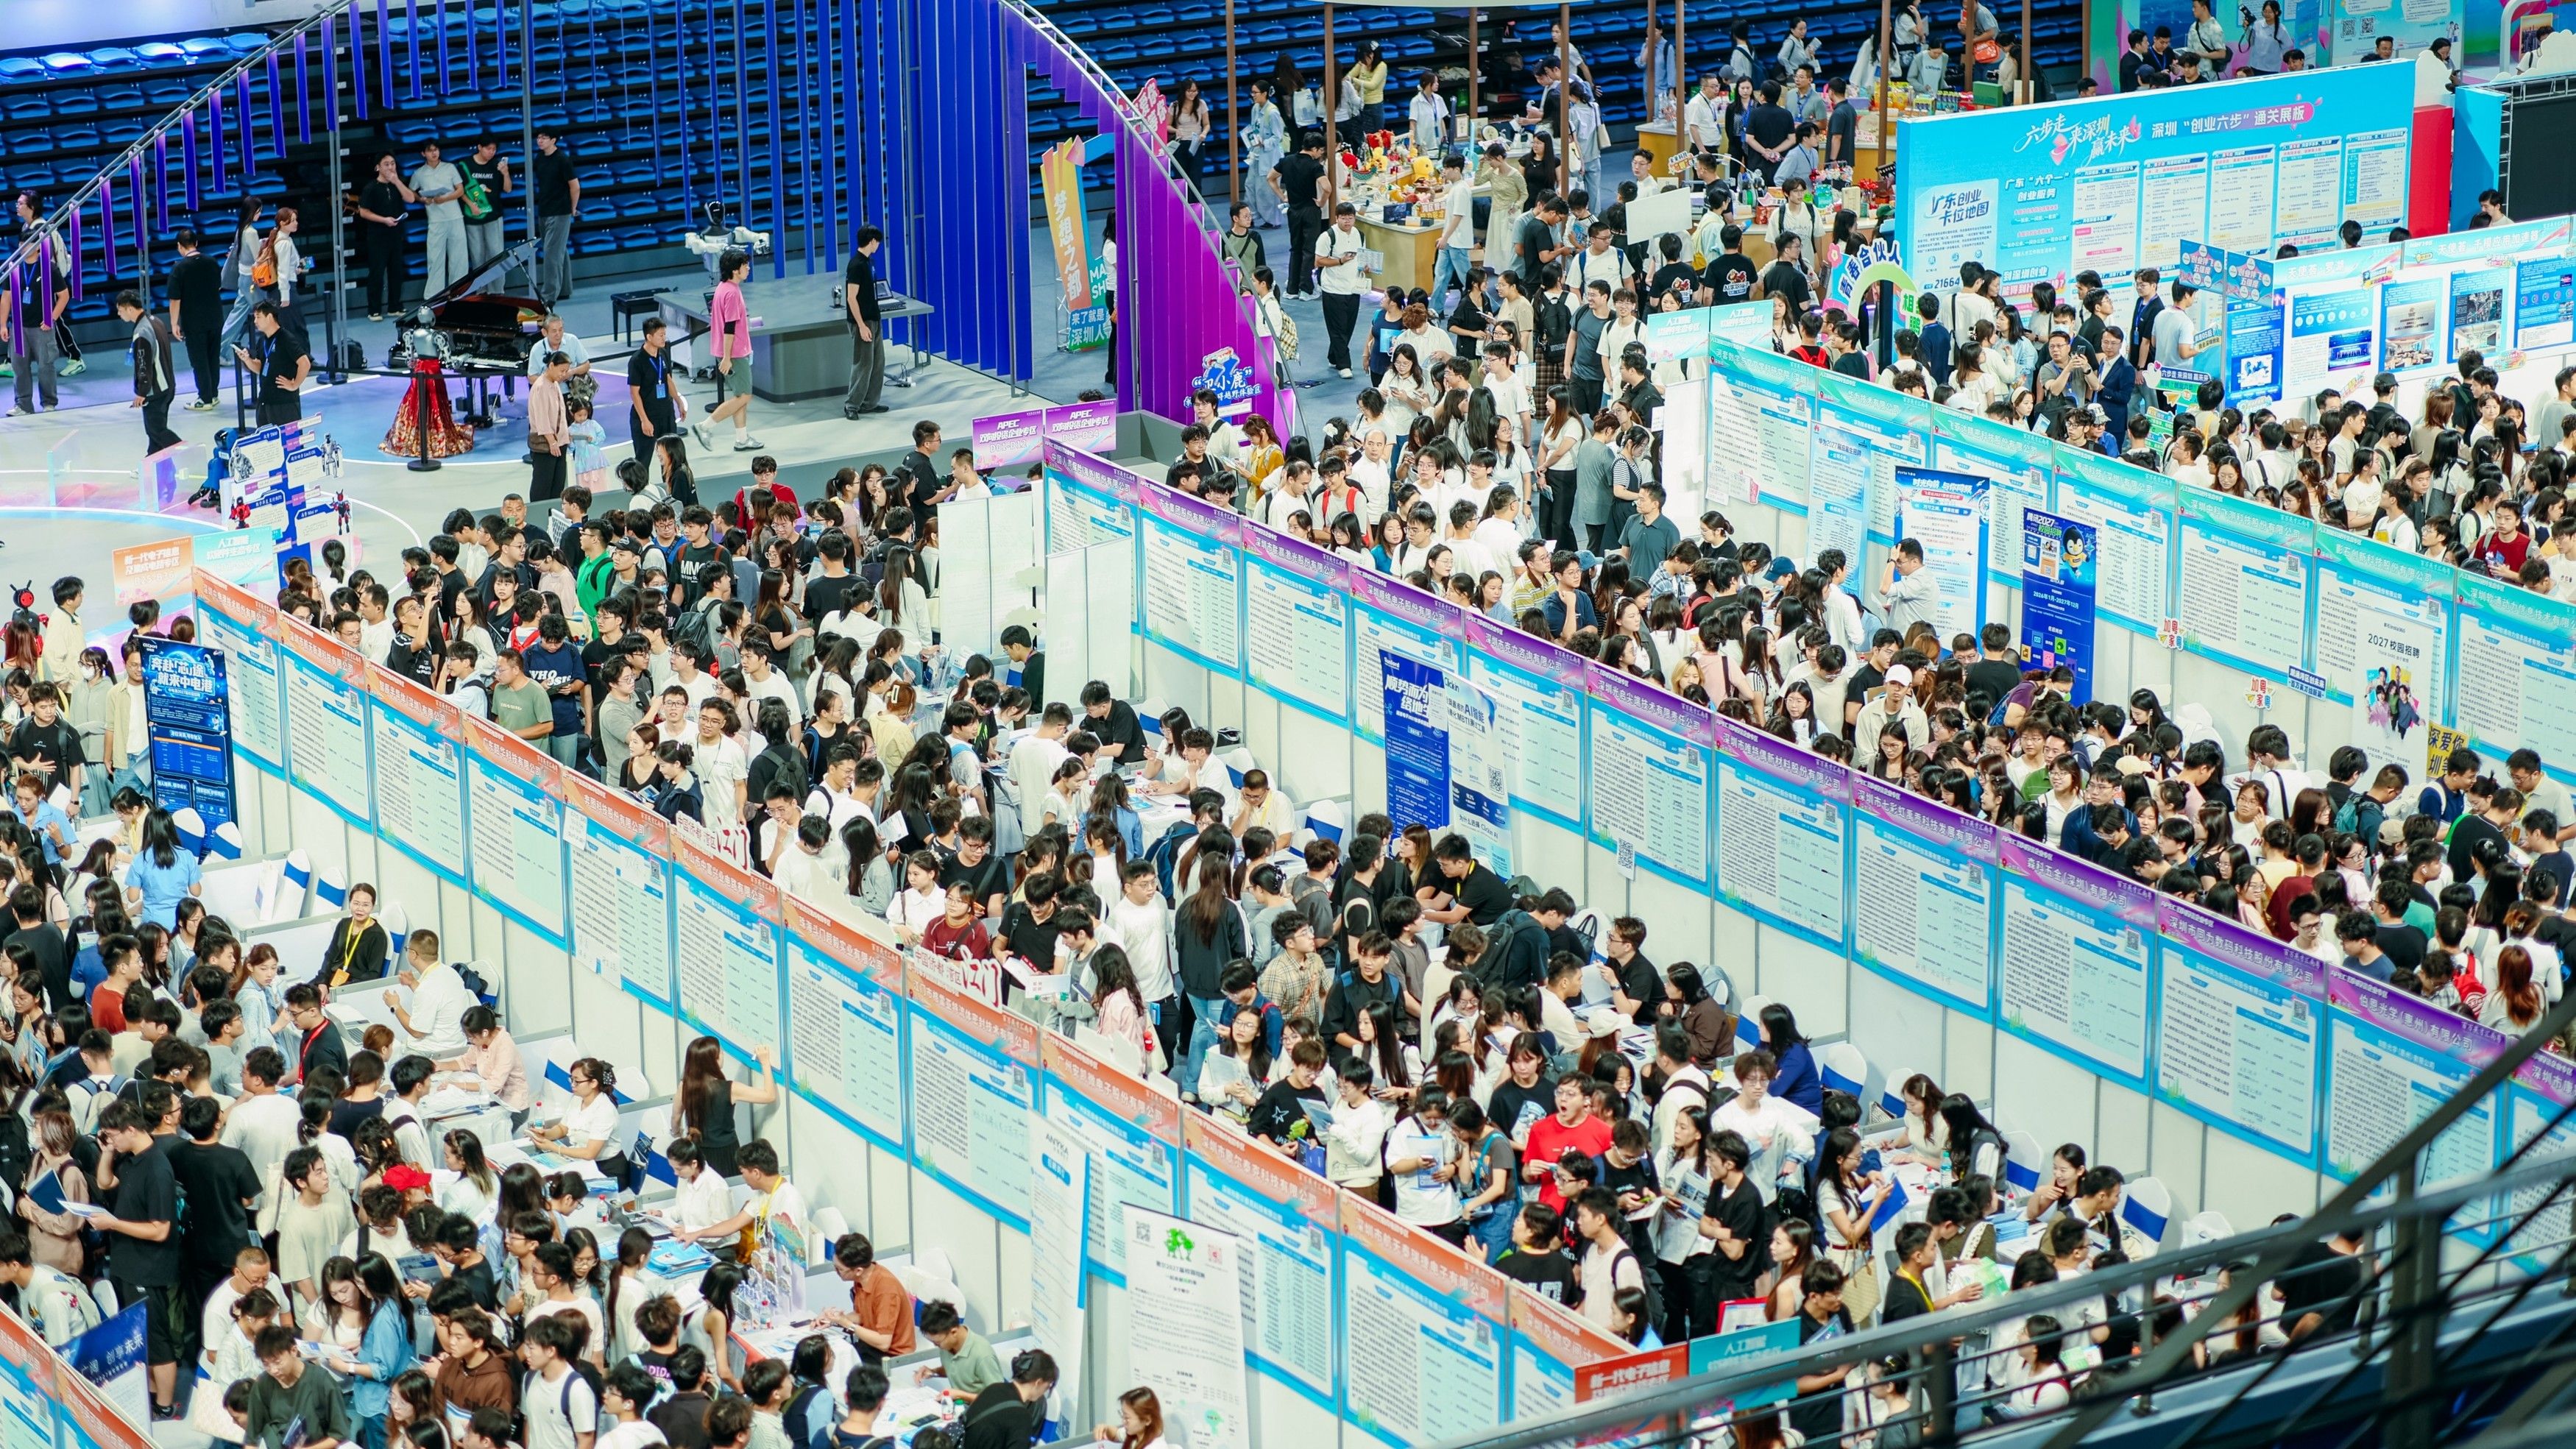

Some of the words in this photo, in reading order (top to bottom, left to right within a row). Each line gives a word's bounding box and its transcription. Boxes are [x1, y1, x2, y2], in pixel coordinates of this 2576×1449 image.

[2017, 113, 2074, 149] 六步走
[2064, 114, 2111, 152] 来深圳
[1932, 189, 1981, 214] 广东创业
[1939, 201, 1989, 227] 卡位地图
[1053, 189, 1083, 302] 梦想之都
[1839, 243, 1903, 300] 青春合伙人
[1934, 277, 1960, 288] 21664
[1070, 409, 1093, 420] APEC
[1848, 389, 1900, 416] 华为技术有限公司
[997, 419, 1020, 428] APEC
[1159, 499, 1217, 531] 方大集团股份有限公司
[2336, 542, 2431, 586] 影石创新科技股份有限公司
[1367, 584, 1444, 626] 深圳顺络电子股份有限公司
[2368, 633, 2389, 649] 2027
[2390, 640, 2421, 659] 校园招聘
[158, 673, 213, 693] 就来中电港
[1385, 675, 1429, 704] 顺势而为
[1598, 679, 1699, 733] 深圳光启尖端技术有限责任公司
[2429, 726, 2464, 752] 深爱你
[1723, 731, 1840, 793] 深圳市唯特偶新材料股份有限公司
[2169, 914, 2313, 987] 深圳市同为数码科技股份有限公司
[1045, 1133, 1069, 1155] ANYKA
